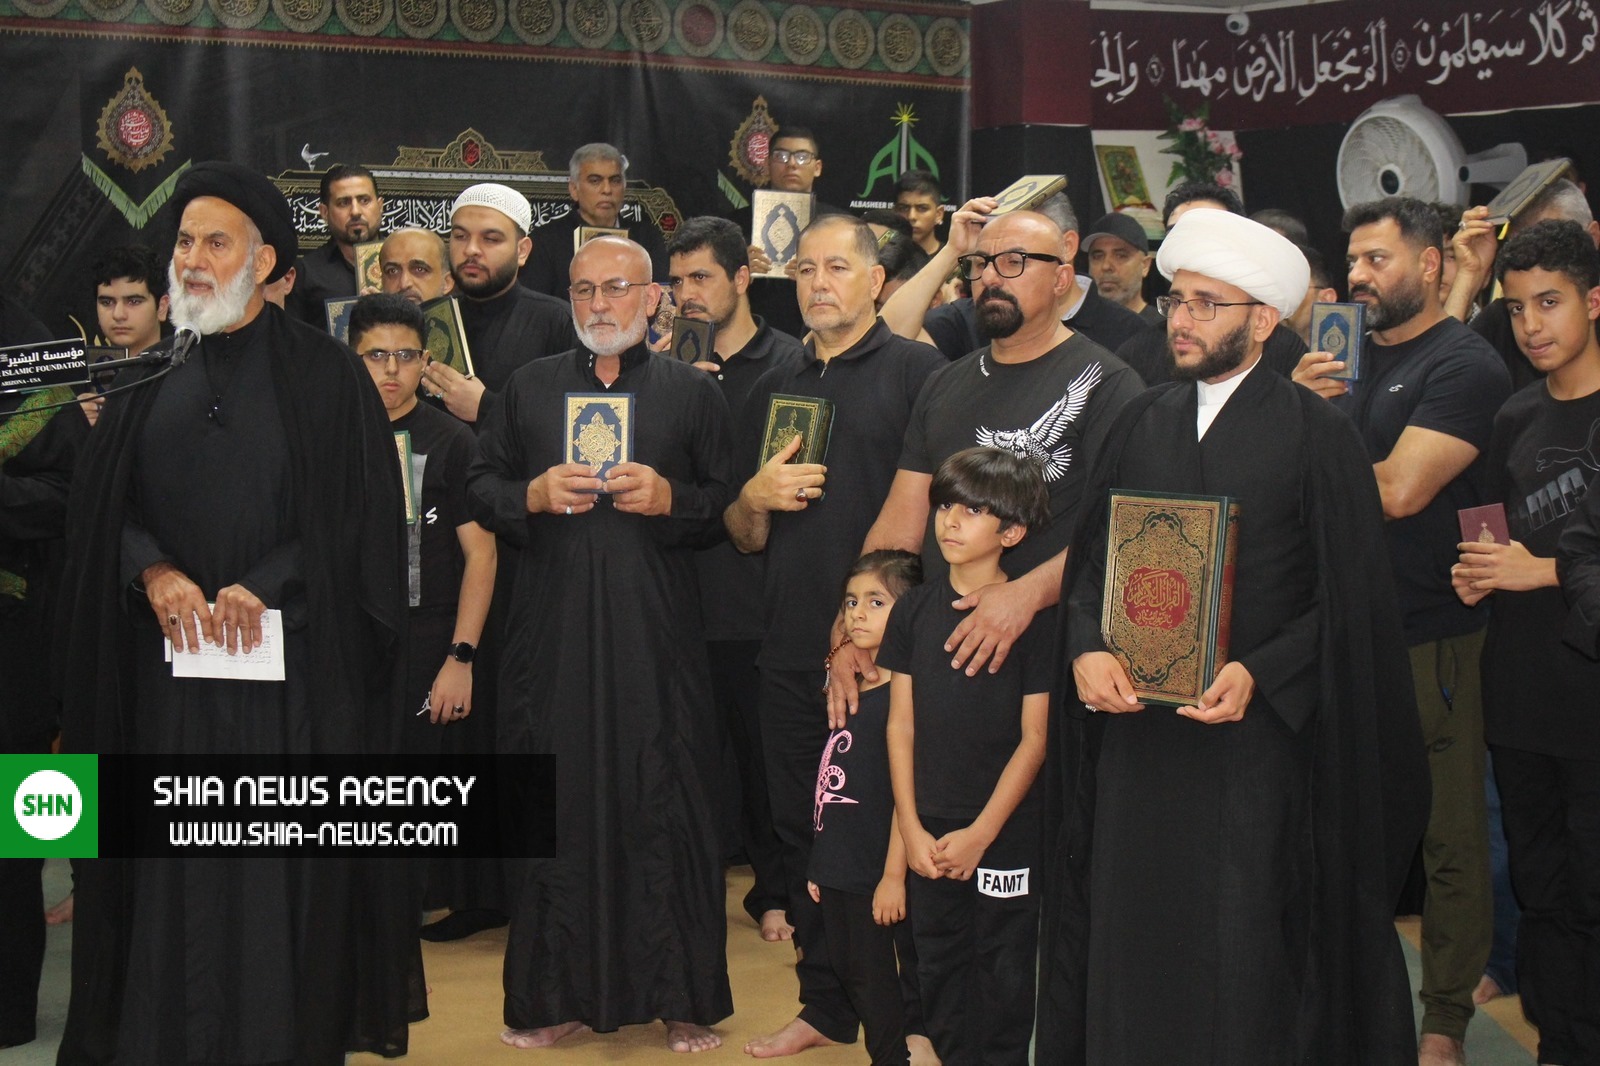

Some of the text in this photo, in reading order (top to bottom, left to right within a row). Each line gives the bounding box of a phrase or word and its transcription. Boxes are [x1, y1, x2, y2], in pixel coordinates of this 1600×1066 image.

[8, 352, 40, 367] البشير
[43, 348, 84, 360] مؤسسة
[1, 361, 86, 376] ISLAMIC FOUNDATION
[983, 873, 1024, 893] FAMT
